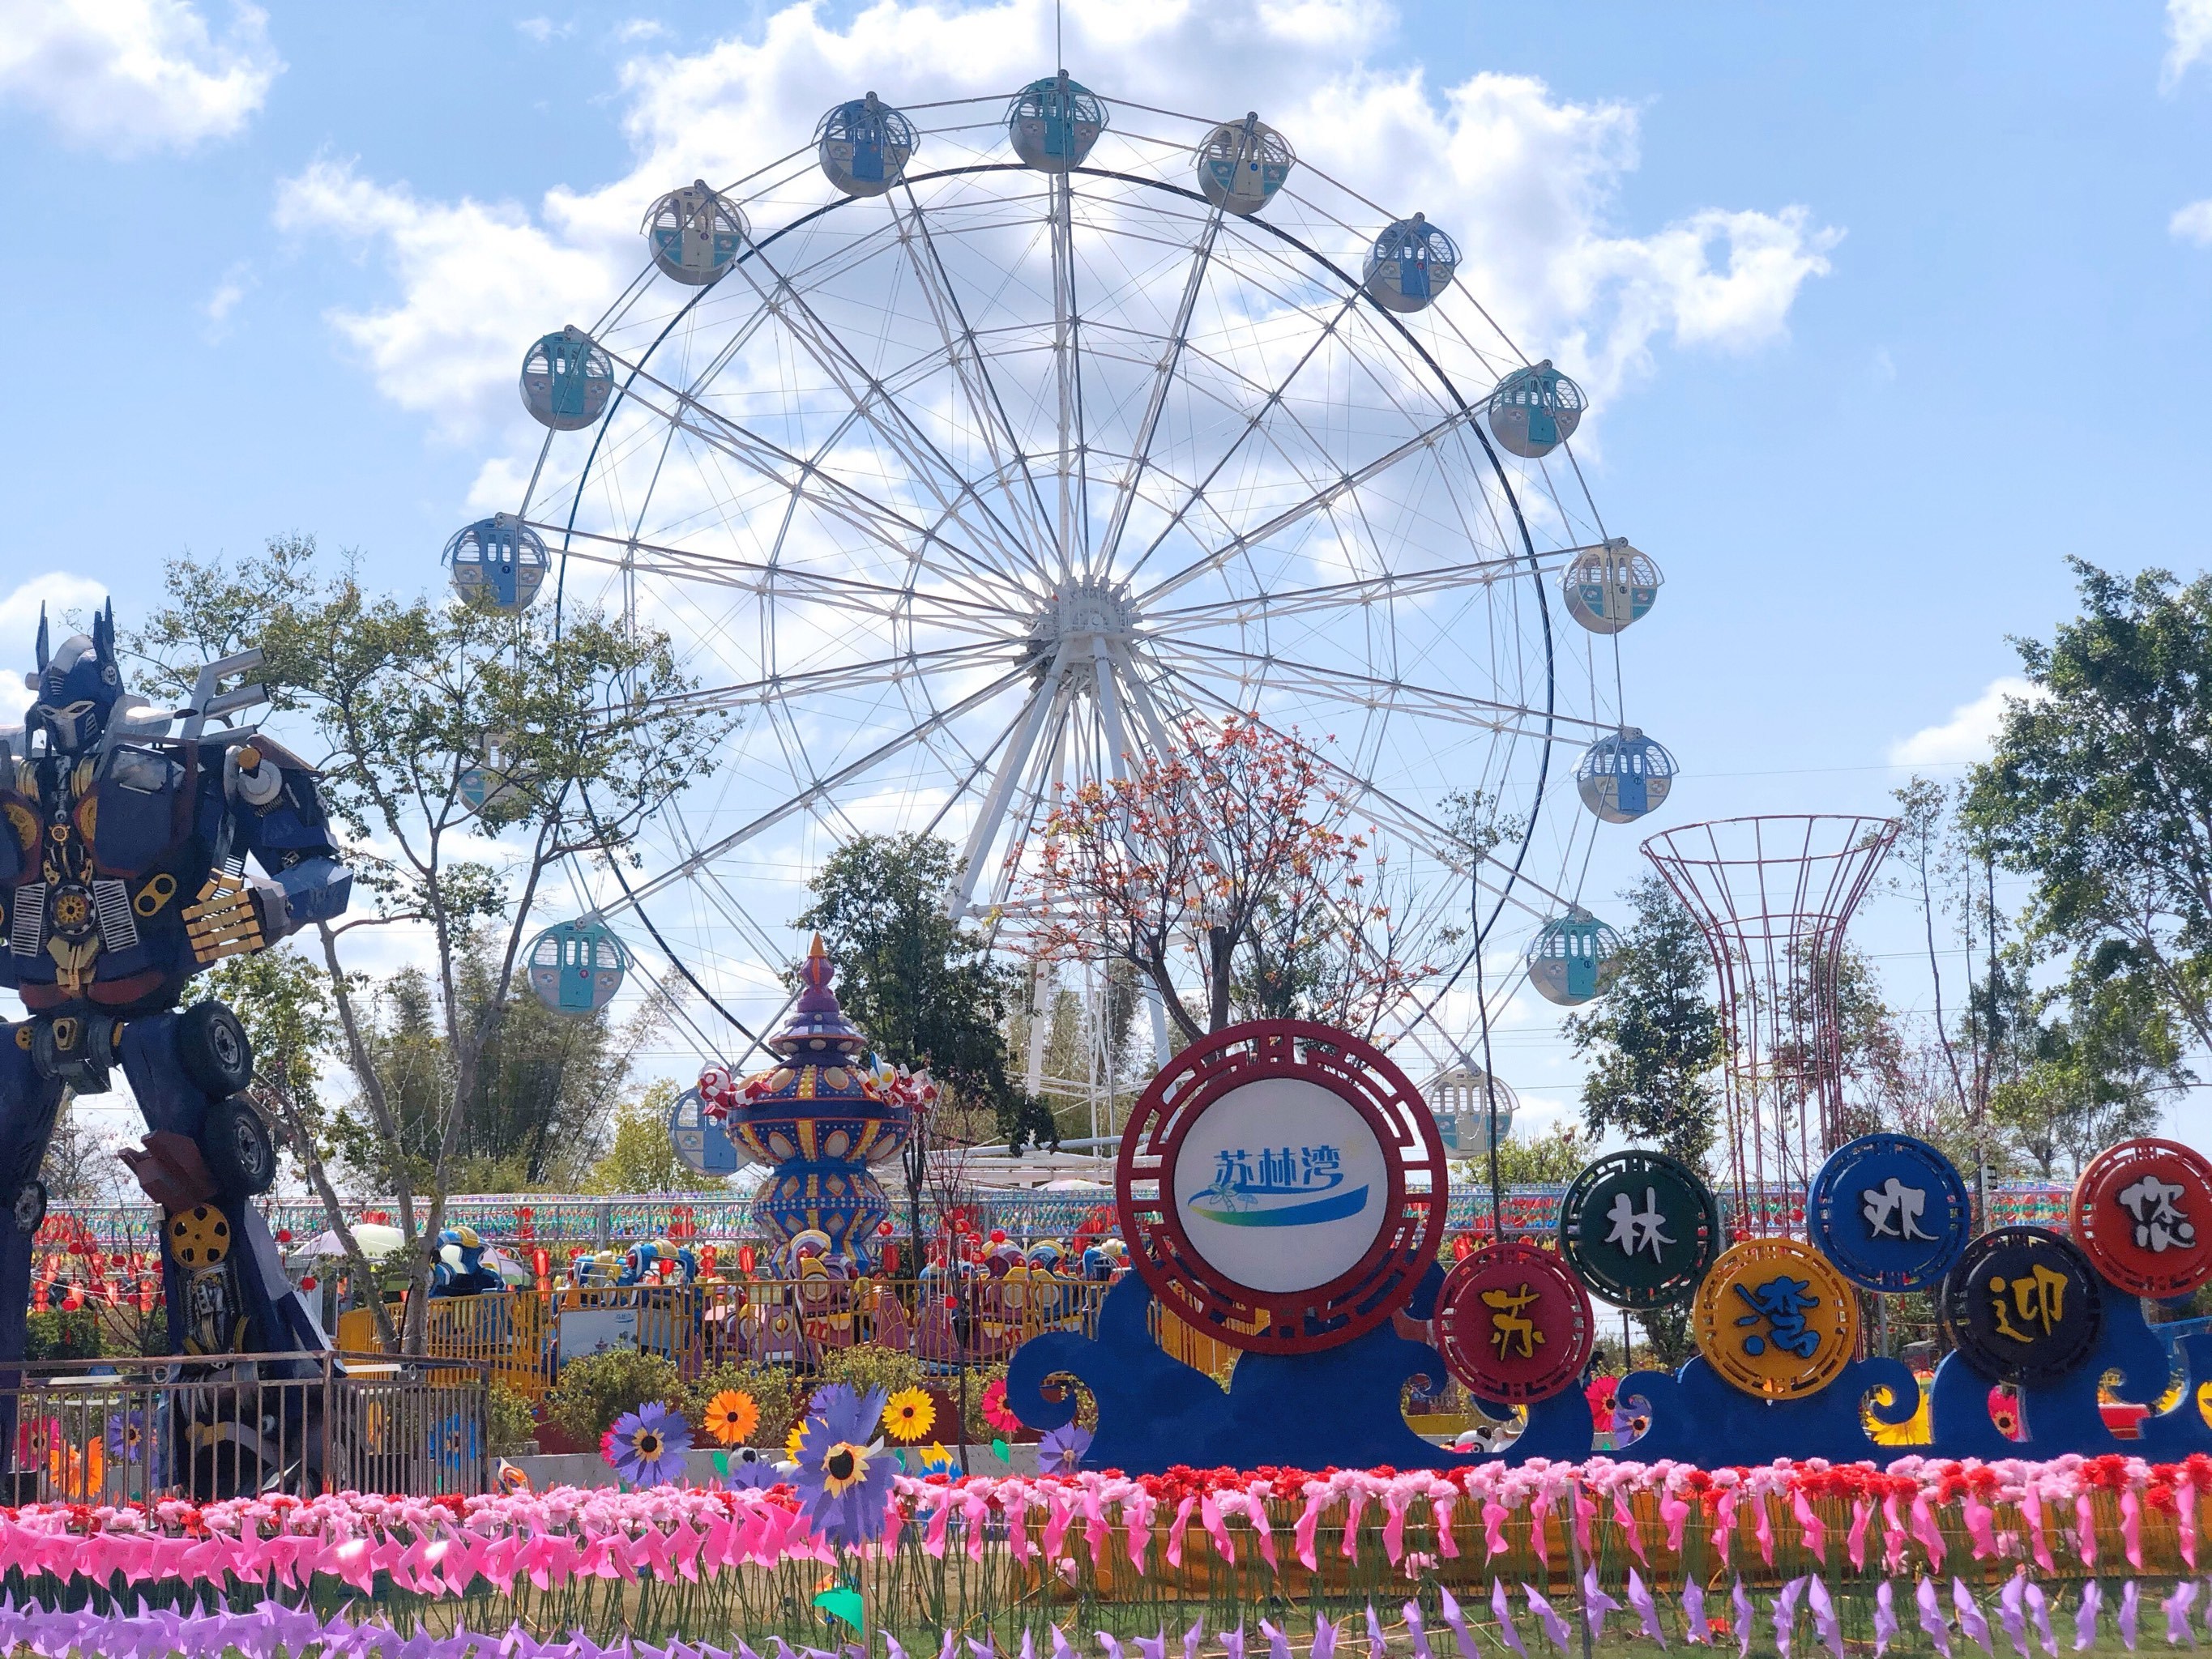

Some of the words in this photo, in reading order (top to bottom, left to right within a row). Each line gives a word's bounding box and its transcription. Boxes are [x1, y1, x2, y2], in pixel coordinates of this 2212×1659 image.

[1214, 1145, 1345, 1186] 苏林湾
[1481, 1283, 1545, 1360] 苏
[1606, 1186, 1677, 1264] 林
[1734, 1275, 1820, 1358] 湾
[1864, 1178, 1939, 1240] 欢
[1990, 1265, 2068, 1343] 迎
[2120, 1175, 2196, 1252] 您
